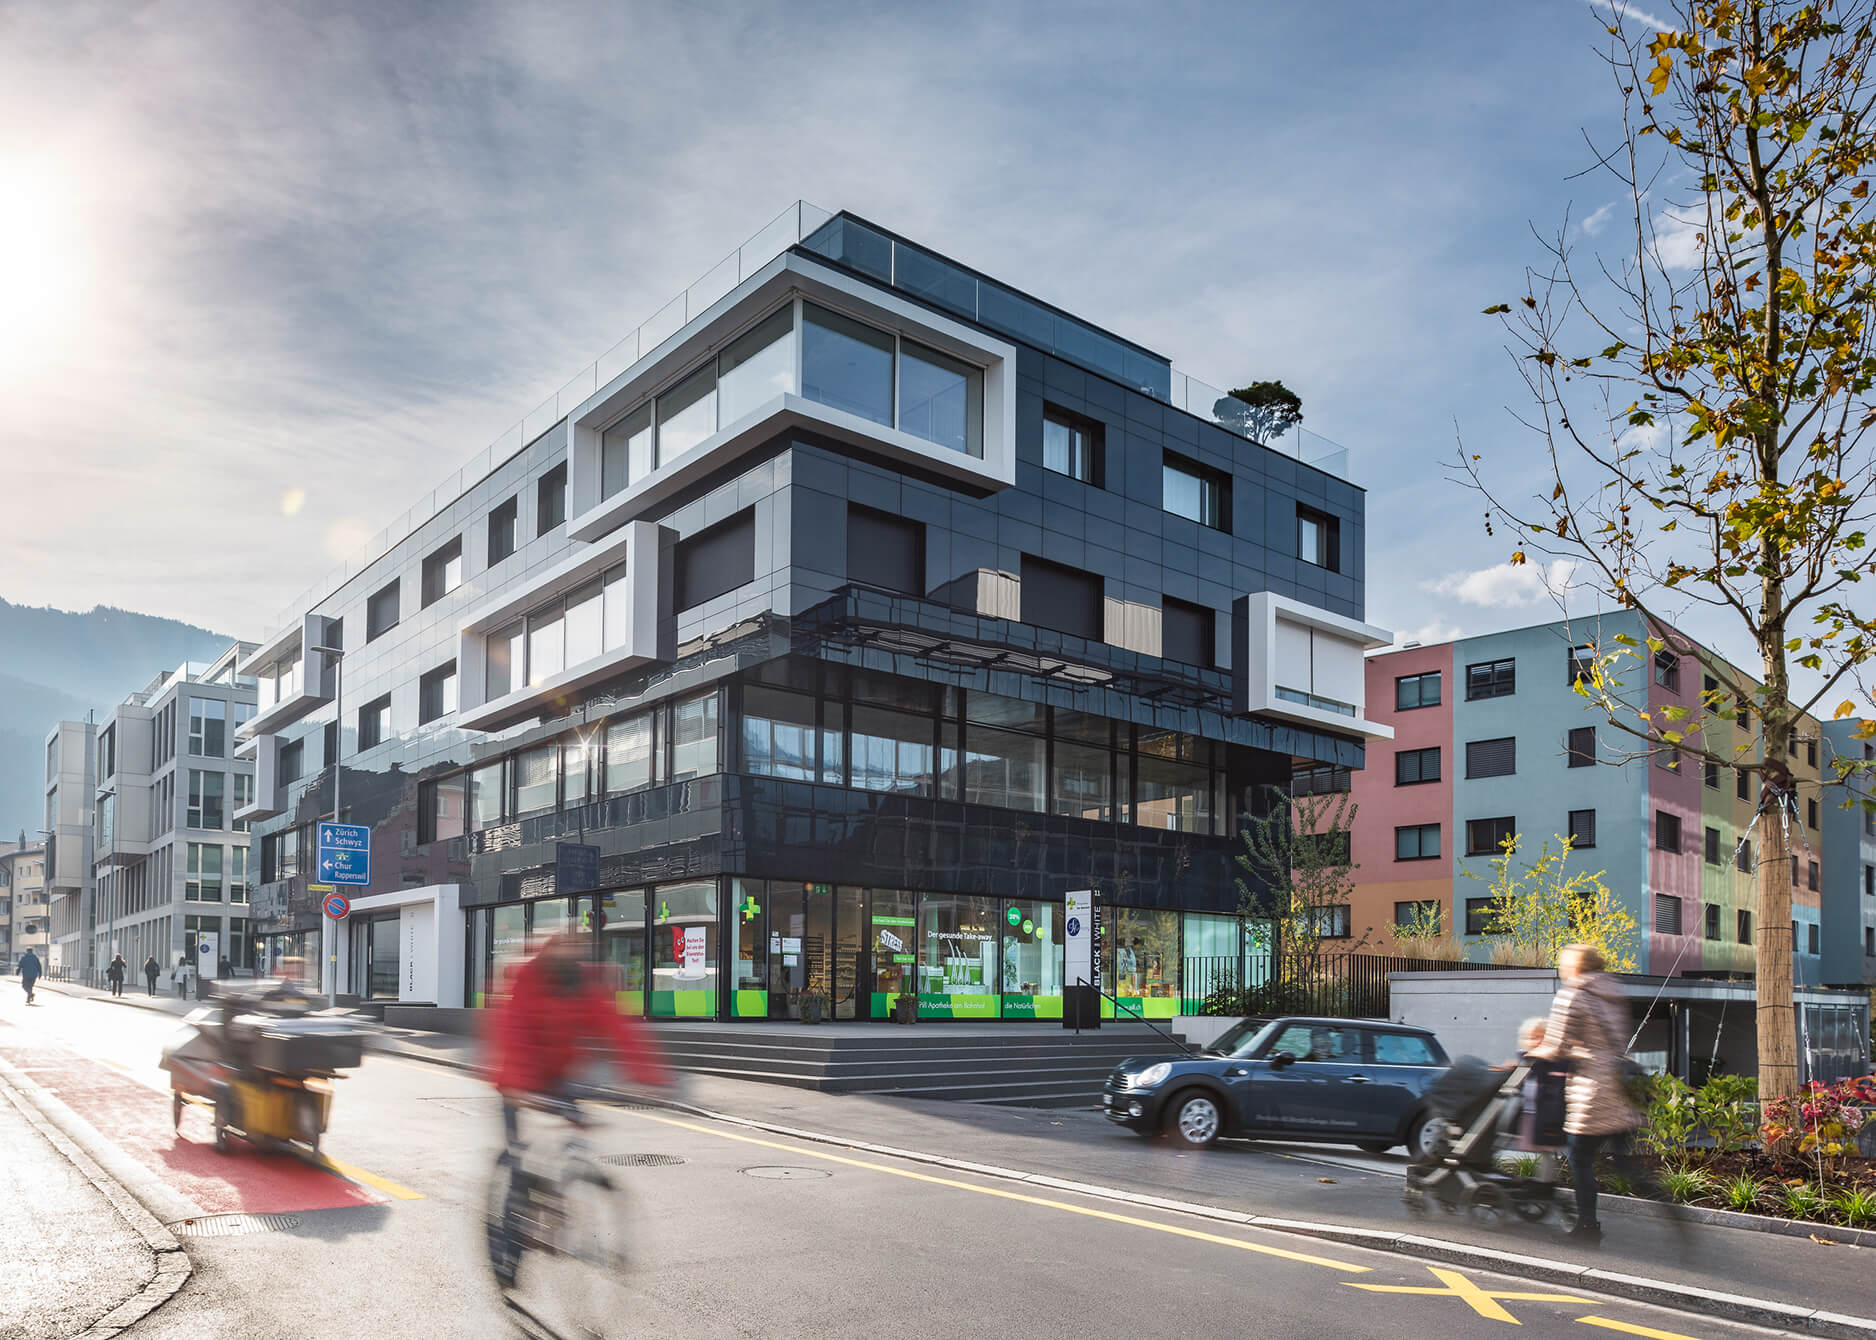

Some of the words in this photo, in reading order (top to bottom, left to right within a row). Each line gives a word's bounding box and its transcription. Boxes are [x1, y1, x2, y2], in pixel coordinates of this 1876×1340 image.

[335, 828, 358, 837] Zürich
[335, 837, 362, 847] Schwyz
[334, 861, 352, 870] Chur
[335, 871, 366, 880] Rapperswil
[927, 930, 938, 938] Der
[938, 931, 963, 940] gesunde
[963, 932, 993, 941] Take-away
[928, 1001, 953, 1010] Apotheke
